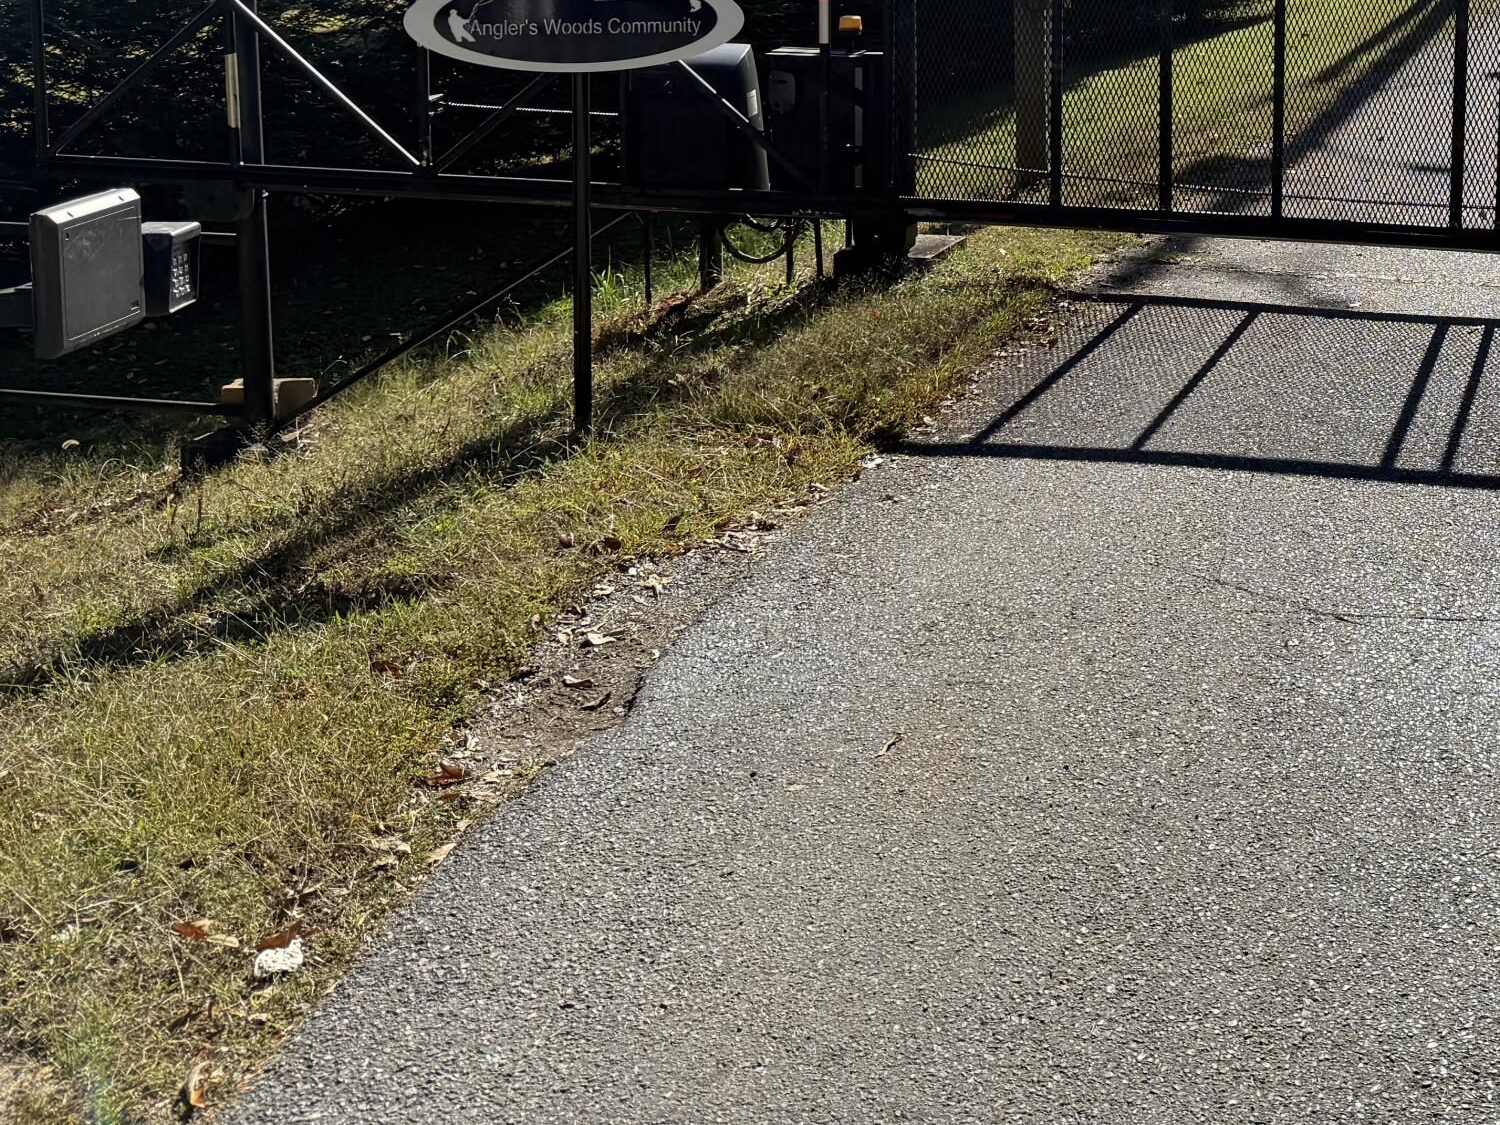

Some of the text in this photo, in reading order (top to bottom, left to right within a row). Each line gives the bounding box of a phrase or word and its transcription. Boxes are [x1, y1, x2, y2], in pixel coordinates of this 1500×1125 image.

[470, 17, 702, 40] Angler's Woods Community
